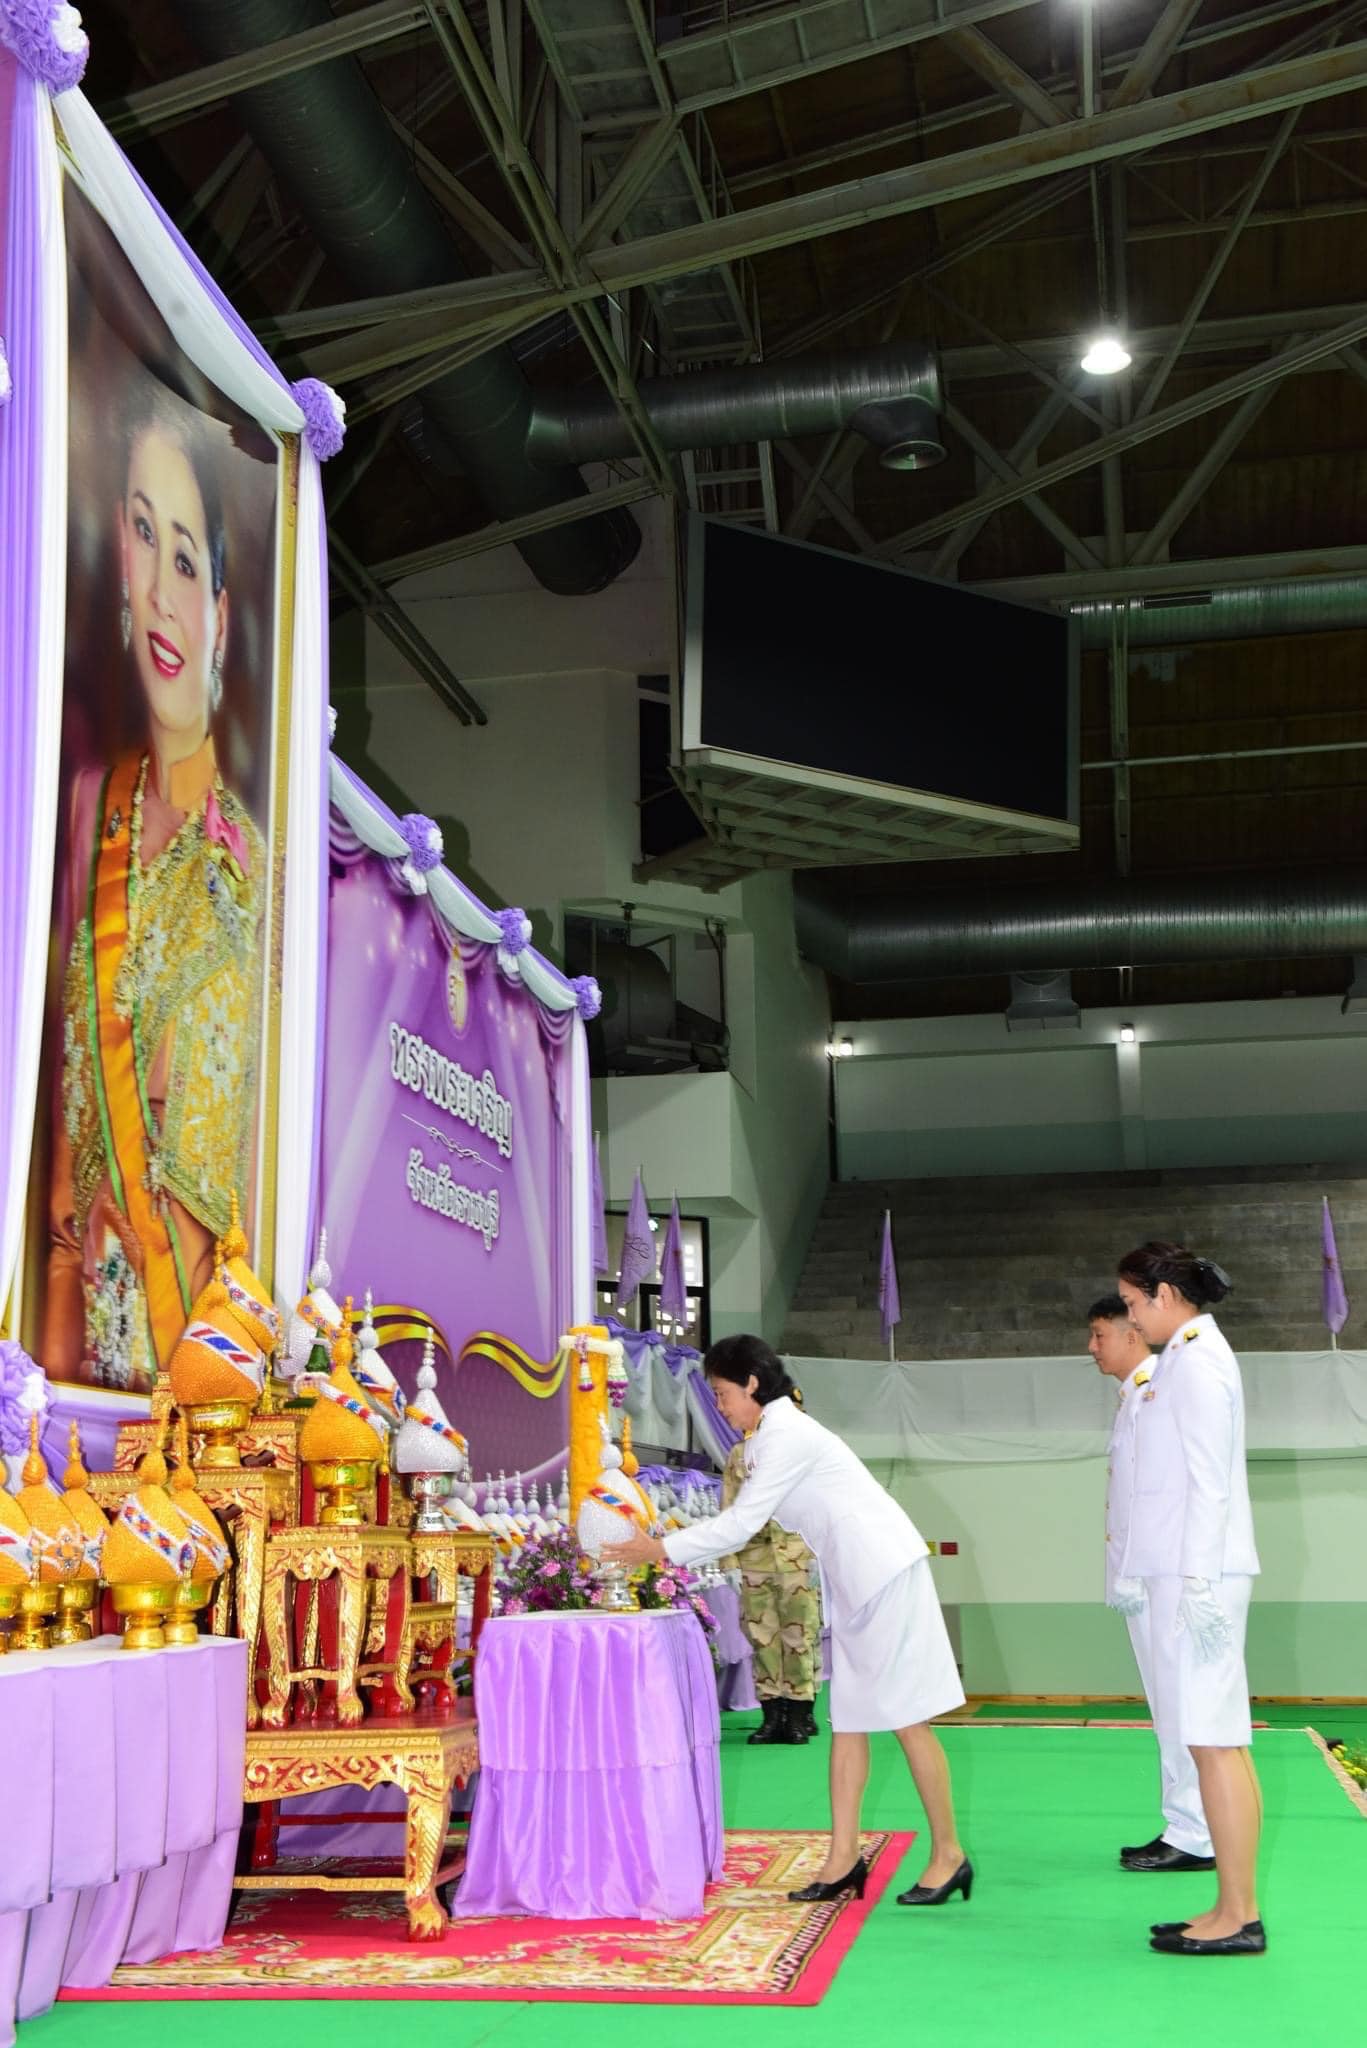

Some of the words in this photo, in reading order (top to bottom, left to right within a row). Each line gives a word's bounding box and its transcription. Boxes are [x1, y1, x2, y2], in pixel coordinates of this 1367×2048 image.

[390, 1021, 512, 1158] ทรงพระเจริญ
